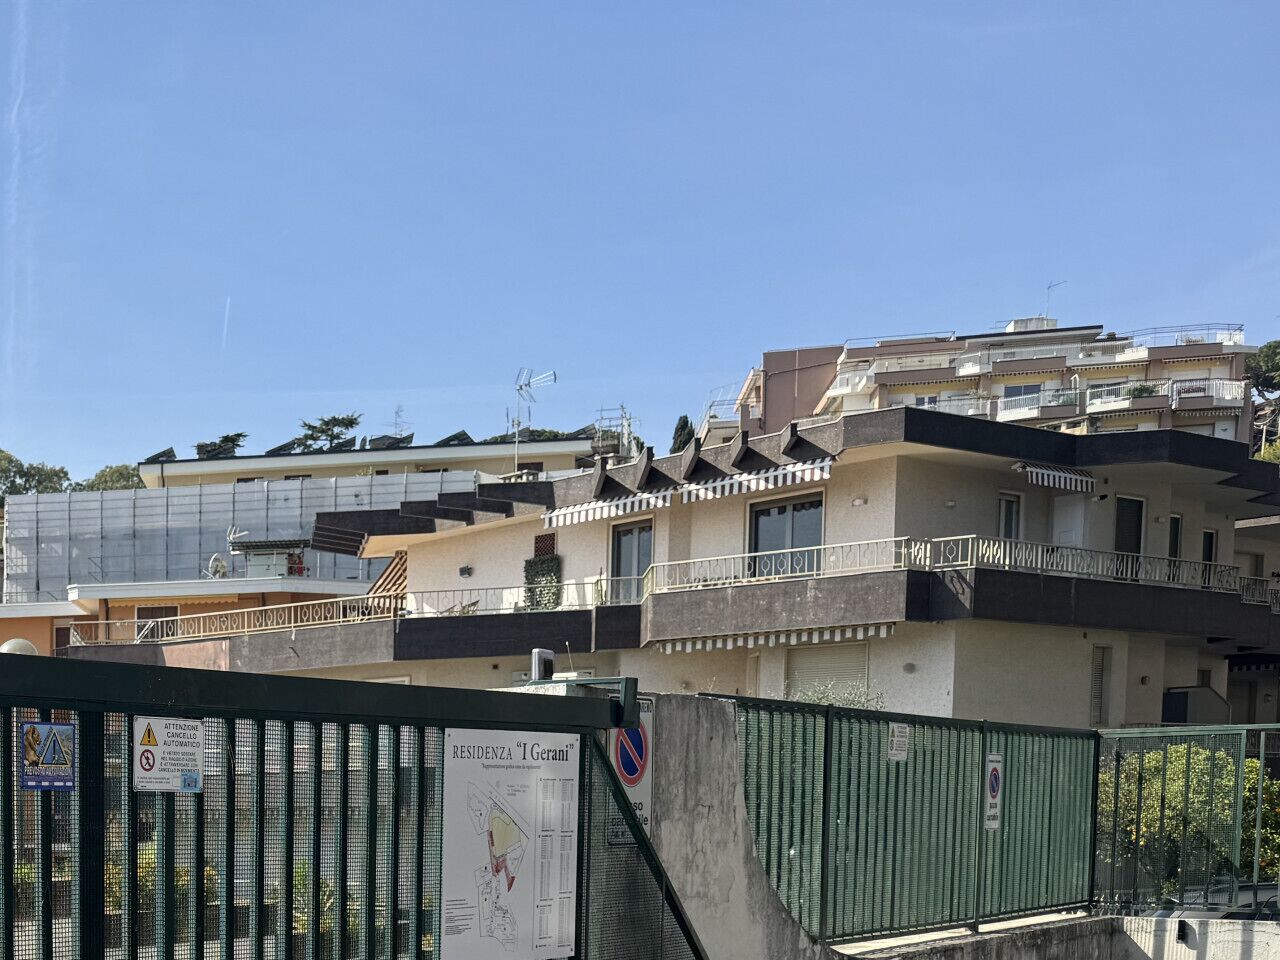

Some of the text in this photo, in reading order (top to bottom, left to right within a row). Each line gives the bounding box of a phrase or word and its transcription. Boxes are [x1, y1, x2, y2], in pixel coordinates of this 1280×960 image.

[164, 722, 199, 731] ATTENZIONE
[166, 731, 198, 740] CANCELLO
[163, 740, 201, 749] AUTOMATICO
[452, 745, 513, 760] RESIDENZA
